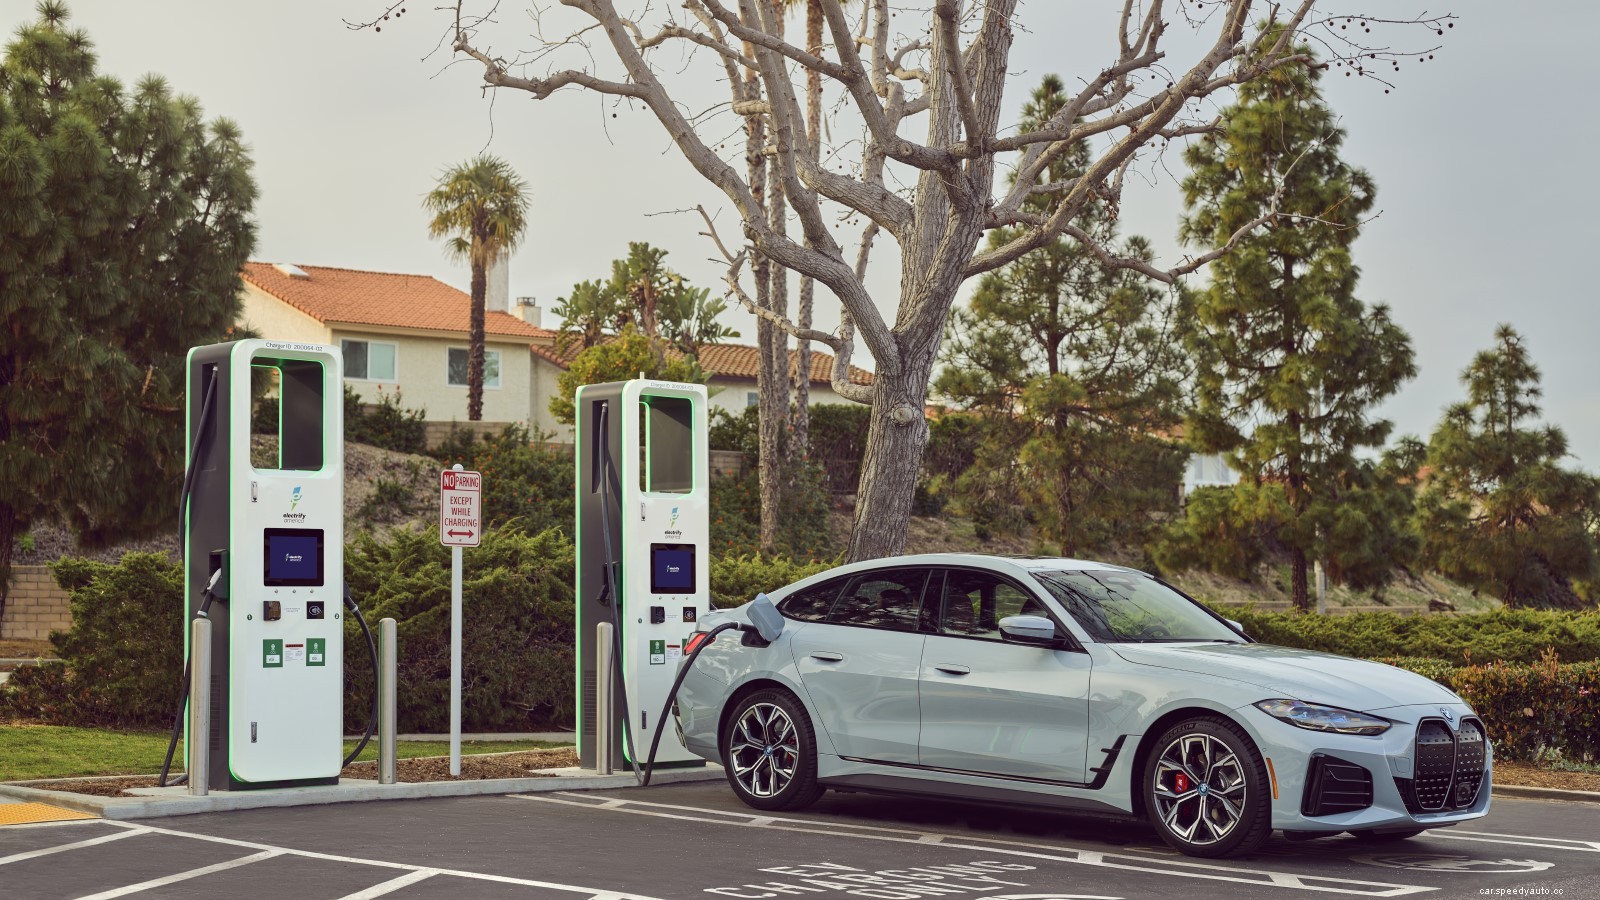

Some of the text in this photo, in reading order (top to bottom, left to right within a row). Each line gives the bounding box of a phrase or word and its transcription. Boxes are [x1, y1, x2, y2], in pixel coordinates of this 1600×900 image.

[444, 474, 478, 488] NO PARKING
[450, 496, 473, 506] EXCEPT
[451, 507, 471, 516] WHILE
[445, 518, 477, 527] CHARGING
[757, 862, 867, 877] EV
[703, 861, 1037, 899] CHARGING
[846, 875, 1031, 900] ONLY
